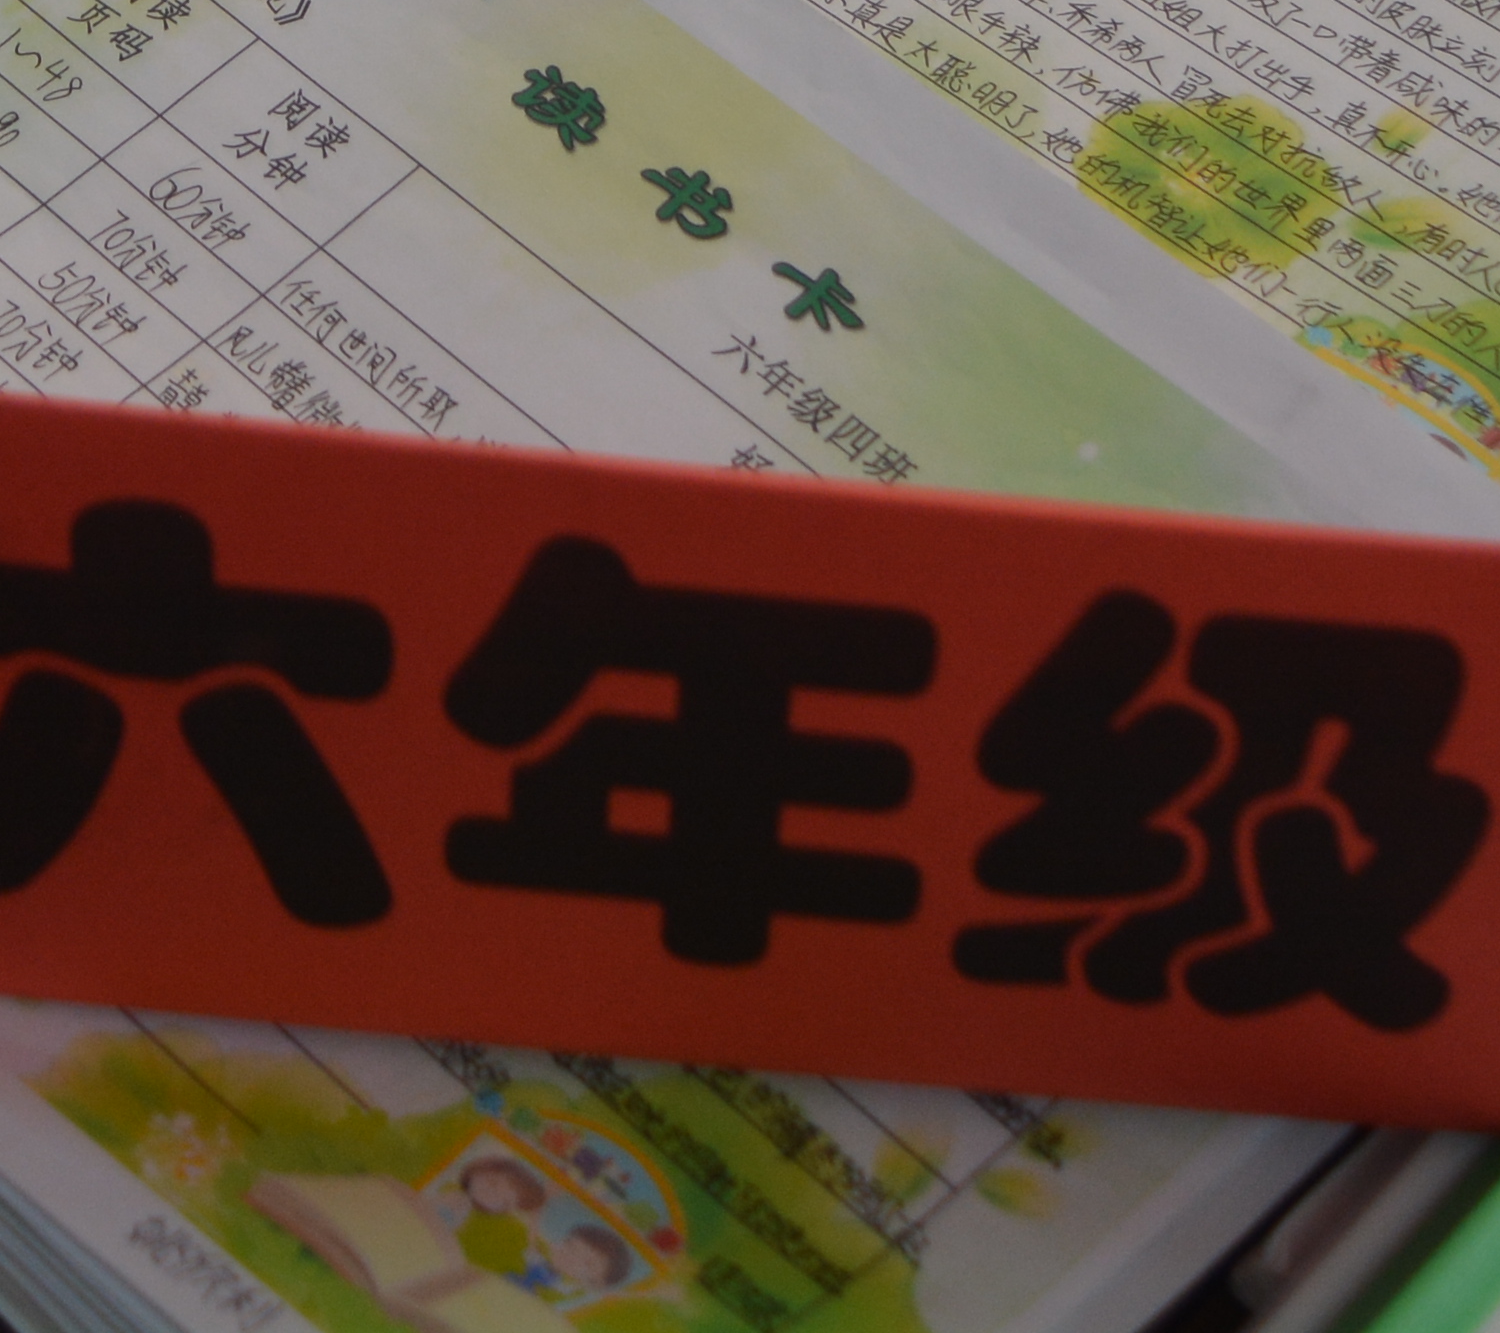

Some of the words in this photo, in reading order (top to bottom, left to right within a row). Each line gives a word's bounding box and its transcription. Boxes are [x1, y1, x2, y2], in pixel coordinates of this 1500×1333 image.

[221, 128, 309, 191] 分钟
[266, 87, 352, 161] 阅读
[510, 63, 867, 334] 读书卡
[710, 333, 919, 479] 六年级四班
